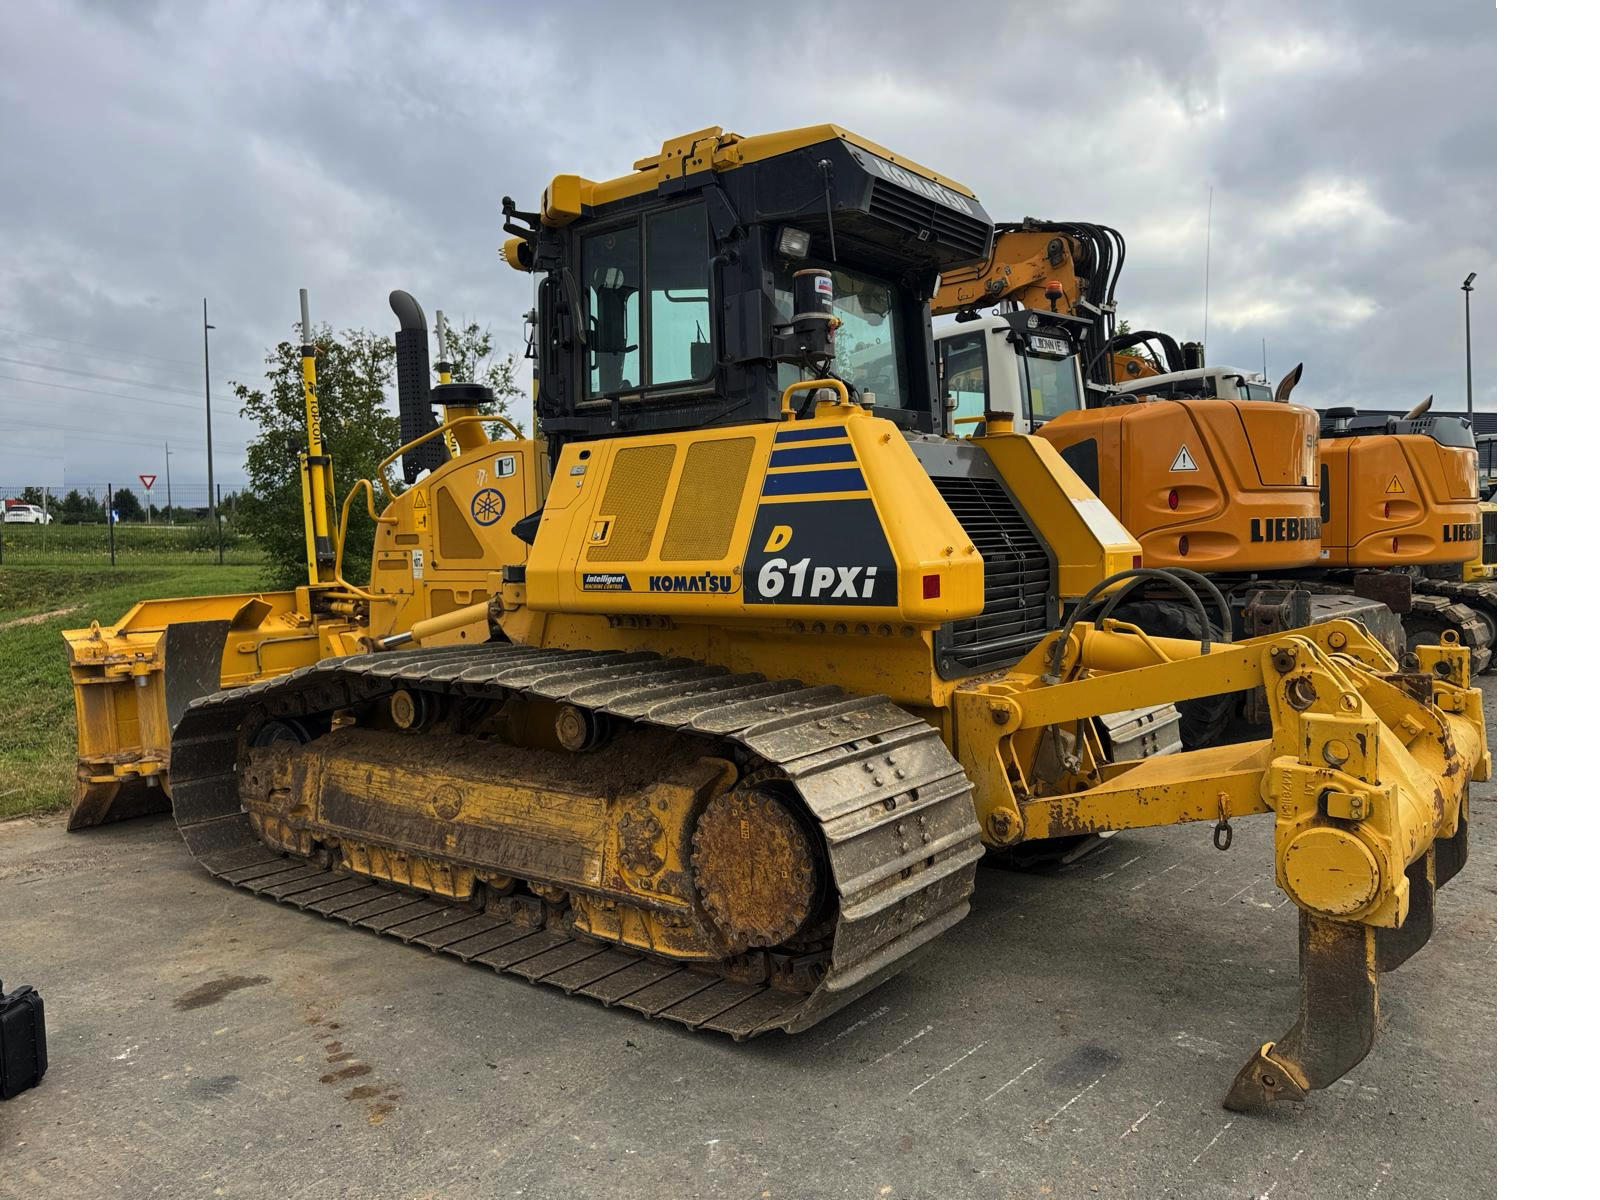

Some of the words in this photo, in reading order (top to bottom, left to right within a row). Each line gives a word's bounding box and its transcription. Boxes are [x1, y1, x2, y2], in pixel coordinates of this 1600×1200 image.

[873, 158, 973, 215] KOMATSU
[763, 525, 793, 553] D
[1443, 523, 1481, 543] LIEBH
[586, 574, 625, 584] intelligent
[649, 571, 732, 592] KOMATSU
[757, 557, 878, 599] 61PXi
